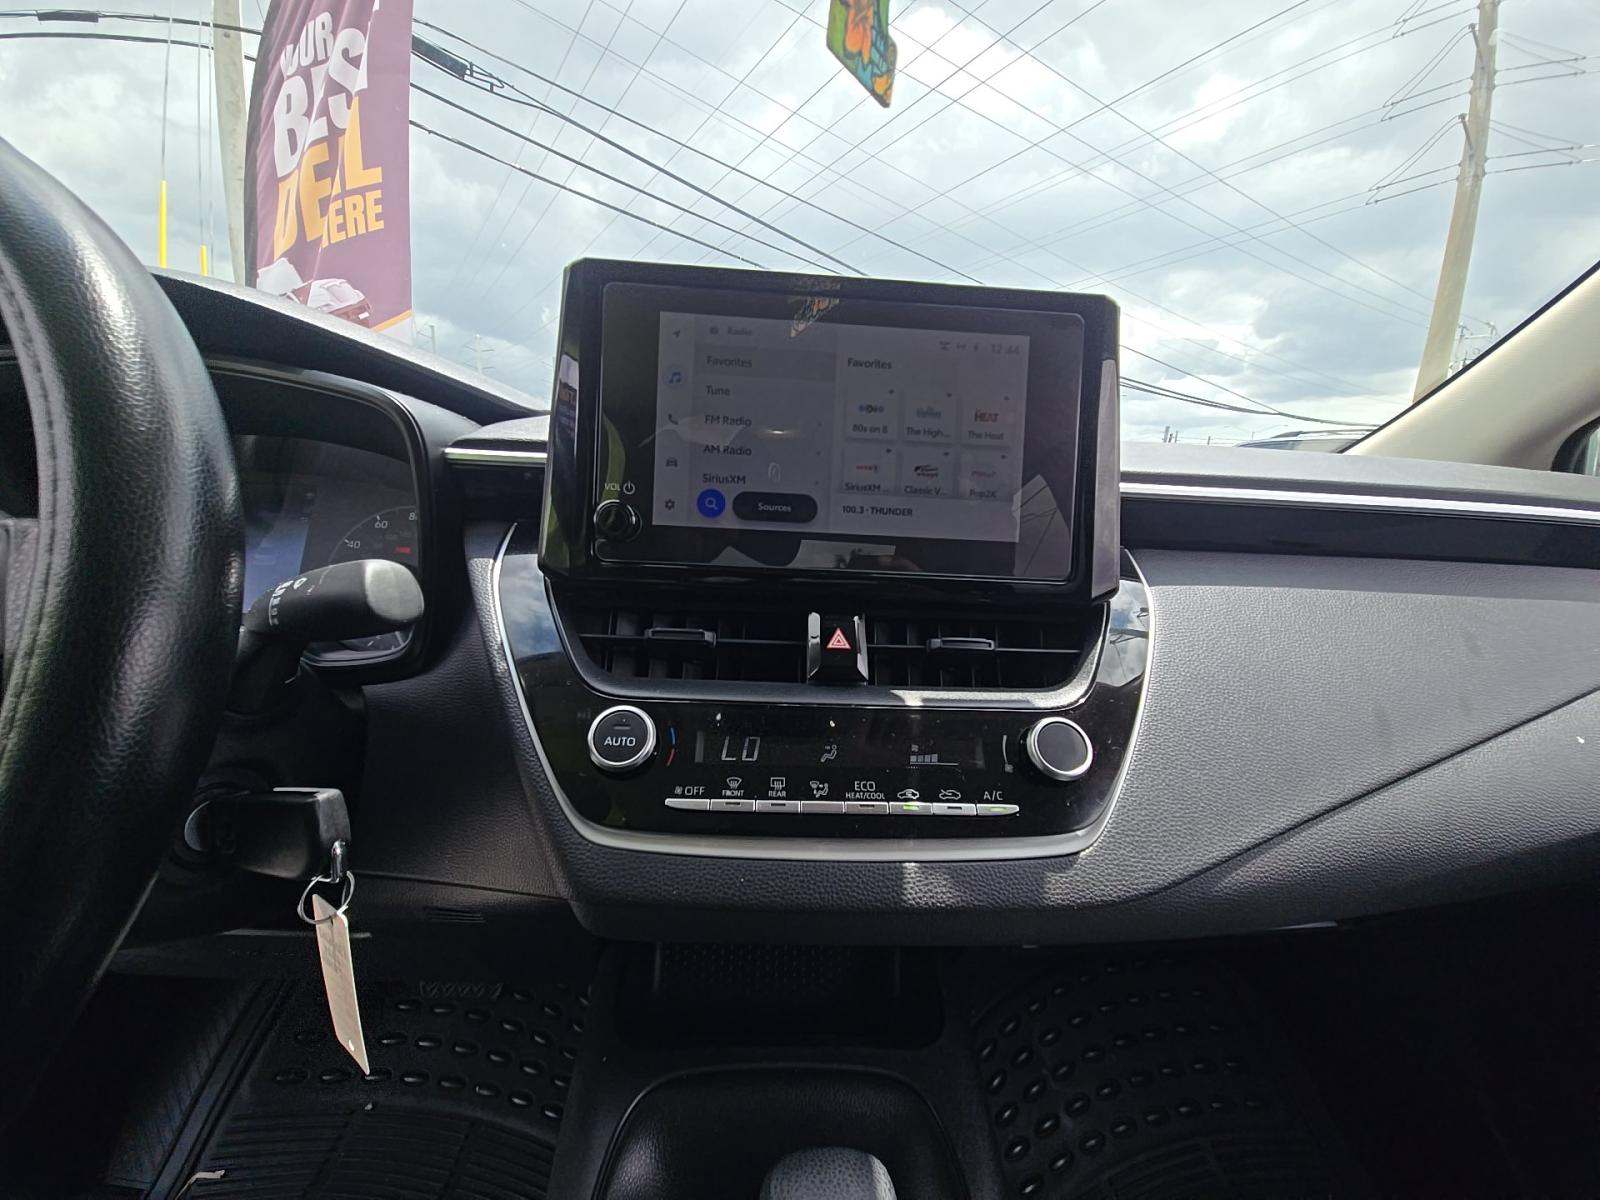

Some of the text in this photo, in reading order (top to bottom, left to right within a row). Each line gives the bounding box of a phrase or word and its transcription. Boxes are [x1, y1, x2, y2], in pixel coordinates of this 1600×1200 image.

[706, 355, 753, 368] Favorites
[847, 357, 893, 370] Favorites
[705, 384, 732, 396] Tune
[704, 413, 753, 427] FM Radio
[906, 426, 920, 435] The
[968, 431, 983, 440] The
[703, 444, 753, 456] AM Radio
[702, 473, 747, 485] SiriusXM
[604, 482, 621, 492] VOL
[904, 484, 931, 495] Classic
[758, 502, 793, 513] Sources
[842, 505, 914, 517] 100.3 THUNDER
[374, 520, 388, 529] 60
[347, 540, 361, 549] 40
[603, 735, 637, 747] AUTO
[720, 735, 761, 764] LO
[684, 785, 706, 796] OFF
[853, 780, 876, 791] ECO
[721, 789, 744, 797] FRONT
[767, 790, 787, 798] REAR
[845, 791, 886, 800] HEAT/COOL
[982, 791, 1004, 802] A/C
